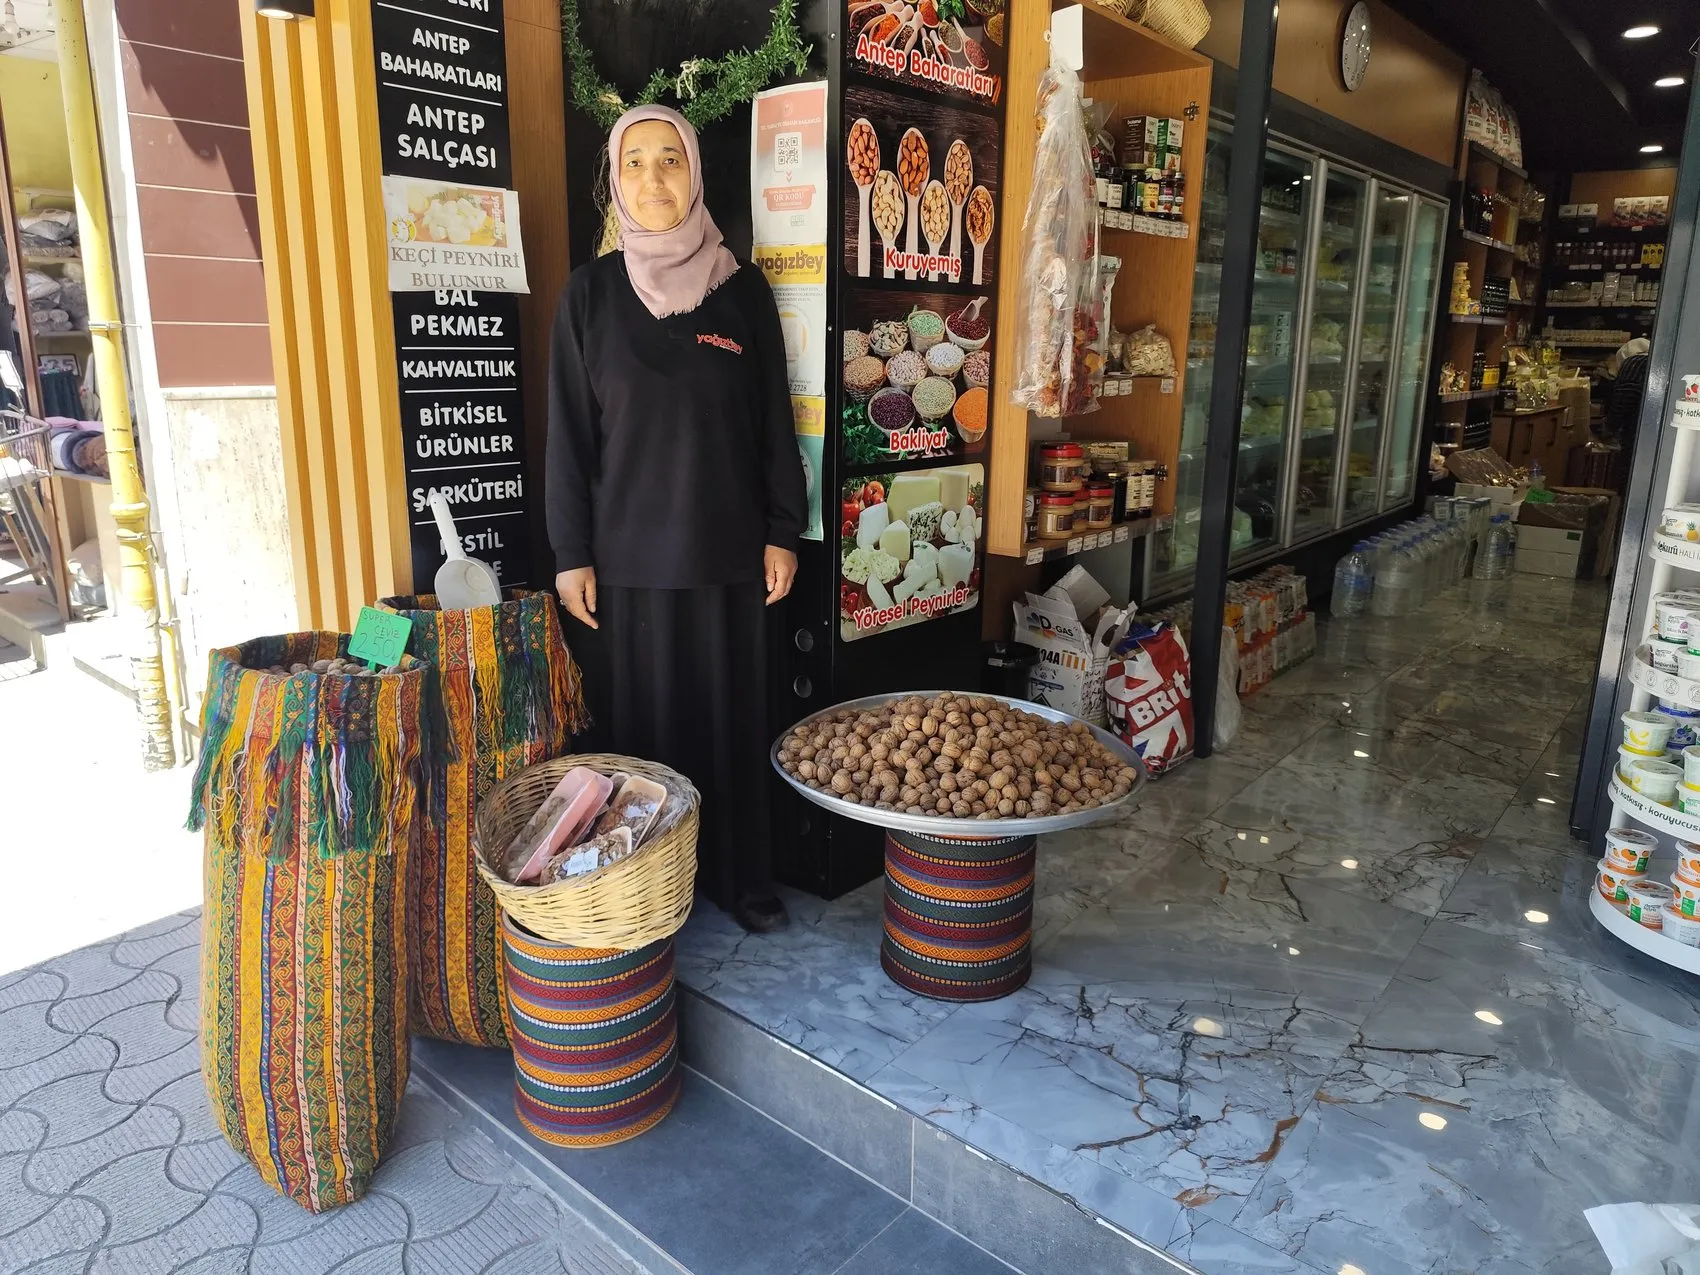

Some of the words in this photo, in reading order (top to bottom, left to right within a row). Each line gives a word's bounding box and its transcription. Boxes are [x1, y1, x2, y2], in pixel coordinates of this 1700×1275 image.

[412, 27, 470, 55] ANTEP
[380, 51, 502, 92] BAHARATLARI
[855, 33, 907, 74] Antep
[911, 50, 994, 97] Baharatları
[406, 103, 485, 135] ANTEP
[397, 133, 496, 169] SALÇASI
[391, 246, 437, 265] KEÇİ
[443, 250, 521, 268] PEYNİRİ
[756, 251, 824, 275] yağızbey
[885, 247, 962, 278] Kuruyemiş
[411, 272, 509, 289] BULUNUR
[434, 288, 478, 307] BAL
[411, 314, 504, 336] PEKMEZ
[402, 360, 516, 378] KAHVALTILIK
[420, 401, 507, 427] BİTKİSEL
[416, 432, 513, 458] ÜRÜNLER
[890, 427, 948, 453] Bakliyat
[412, 474, 523, 512] ŞARKÜTERİ
[440, 528, 504, 556] STİL
[853, 597, 907, 631] Yöresel
[911, 587, 969, 618] Peynirler
